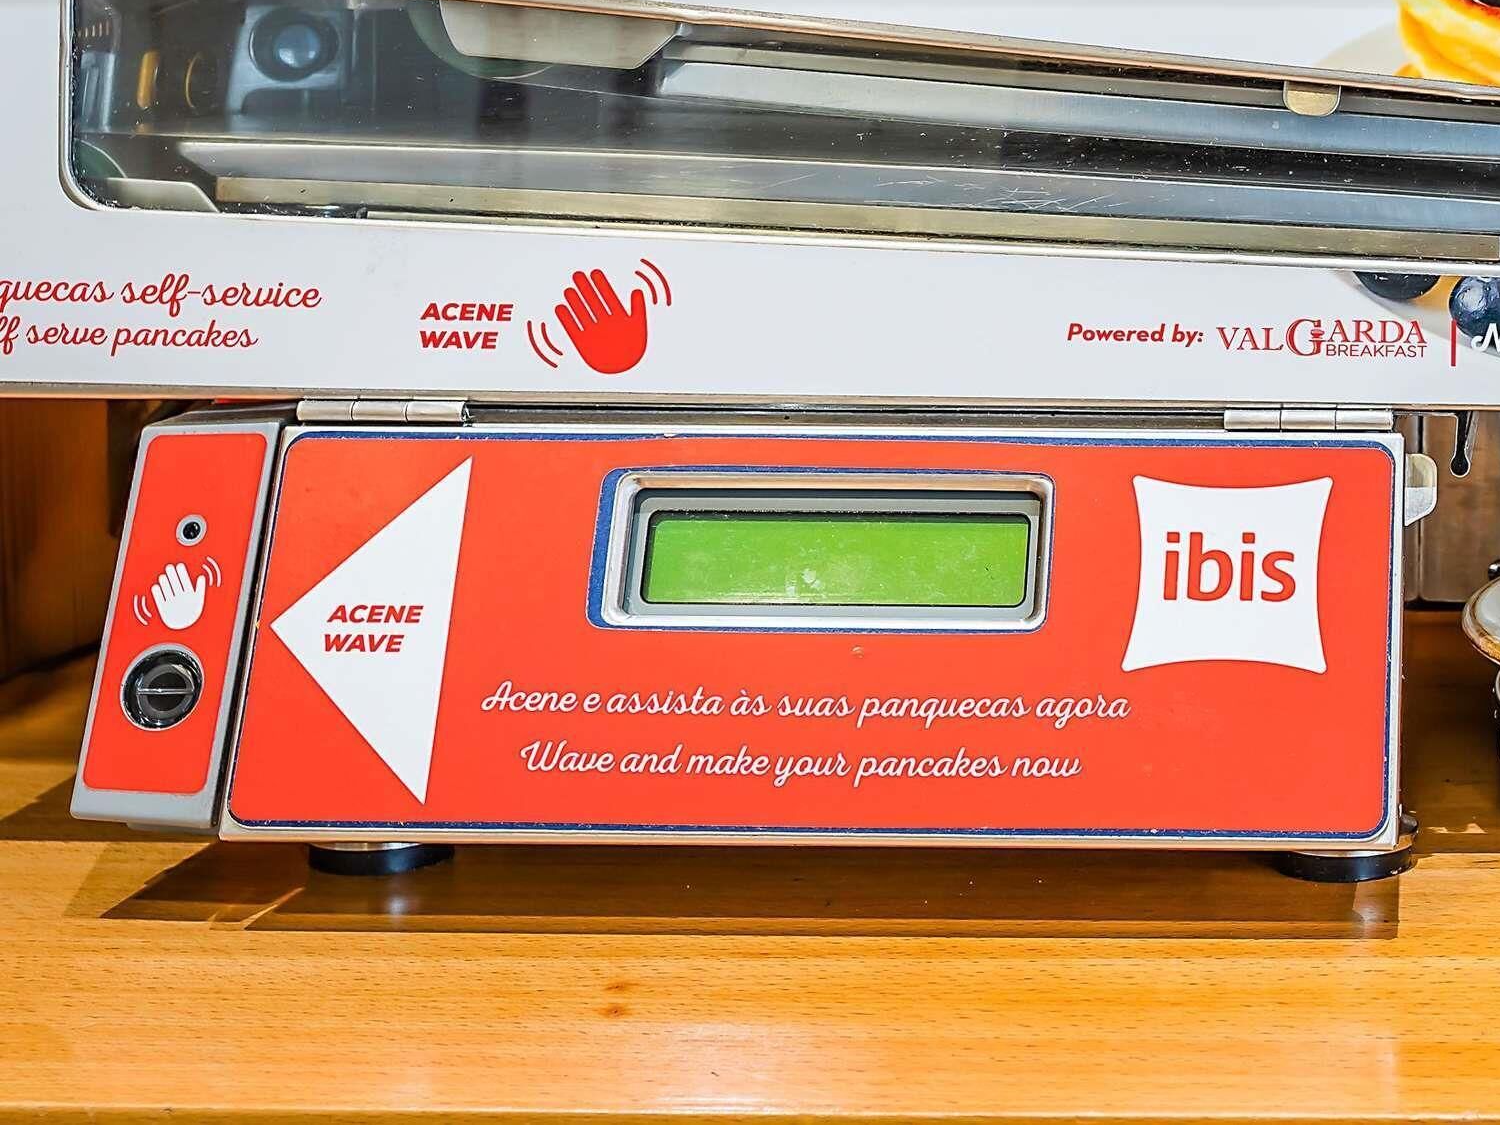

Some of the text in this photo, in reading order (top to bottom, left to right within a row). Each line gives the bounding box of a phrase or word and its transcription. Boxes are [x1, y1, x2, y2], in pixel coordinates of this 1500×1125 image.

[120, 272, 322, 317] self-service
[420, 302, 513, 323] ACENE
[26, 323, 108, 346] serve
[110, 319, 258, 357] pancakes
[419, 330, 498, 350] WAVE
[1067, 322, 1204, 345] Powered by:
[1326, 345, 1428, 358] BREAKFAST
[1162, 530, 1297, 603] ibis
[327, 604, 424, 624] ACENE
[324, 633, 404, 653] WAVE
[481, 681, 1131, 729] Acene e assista às suas panquecas agora
[520, 740, 1082, 788] Wave and make your pancakes now
